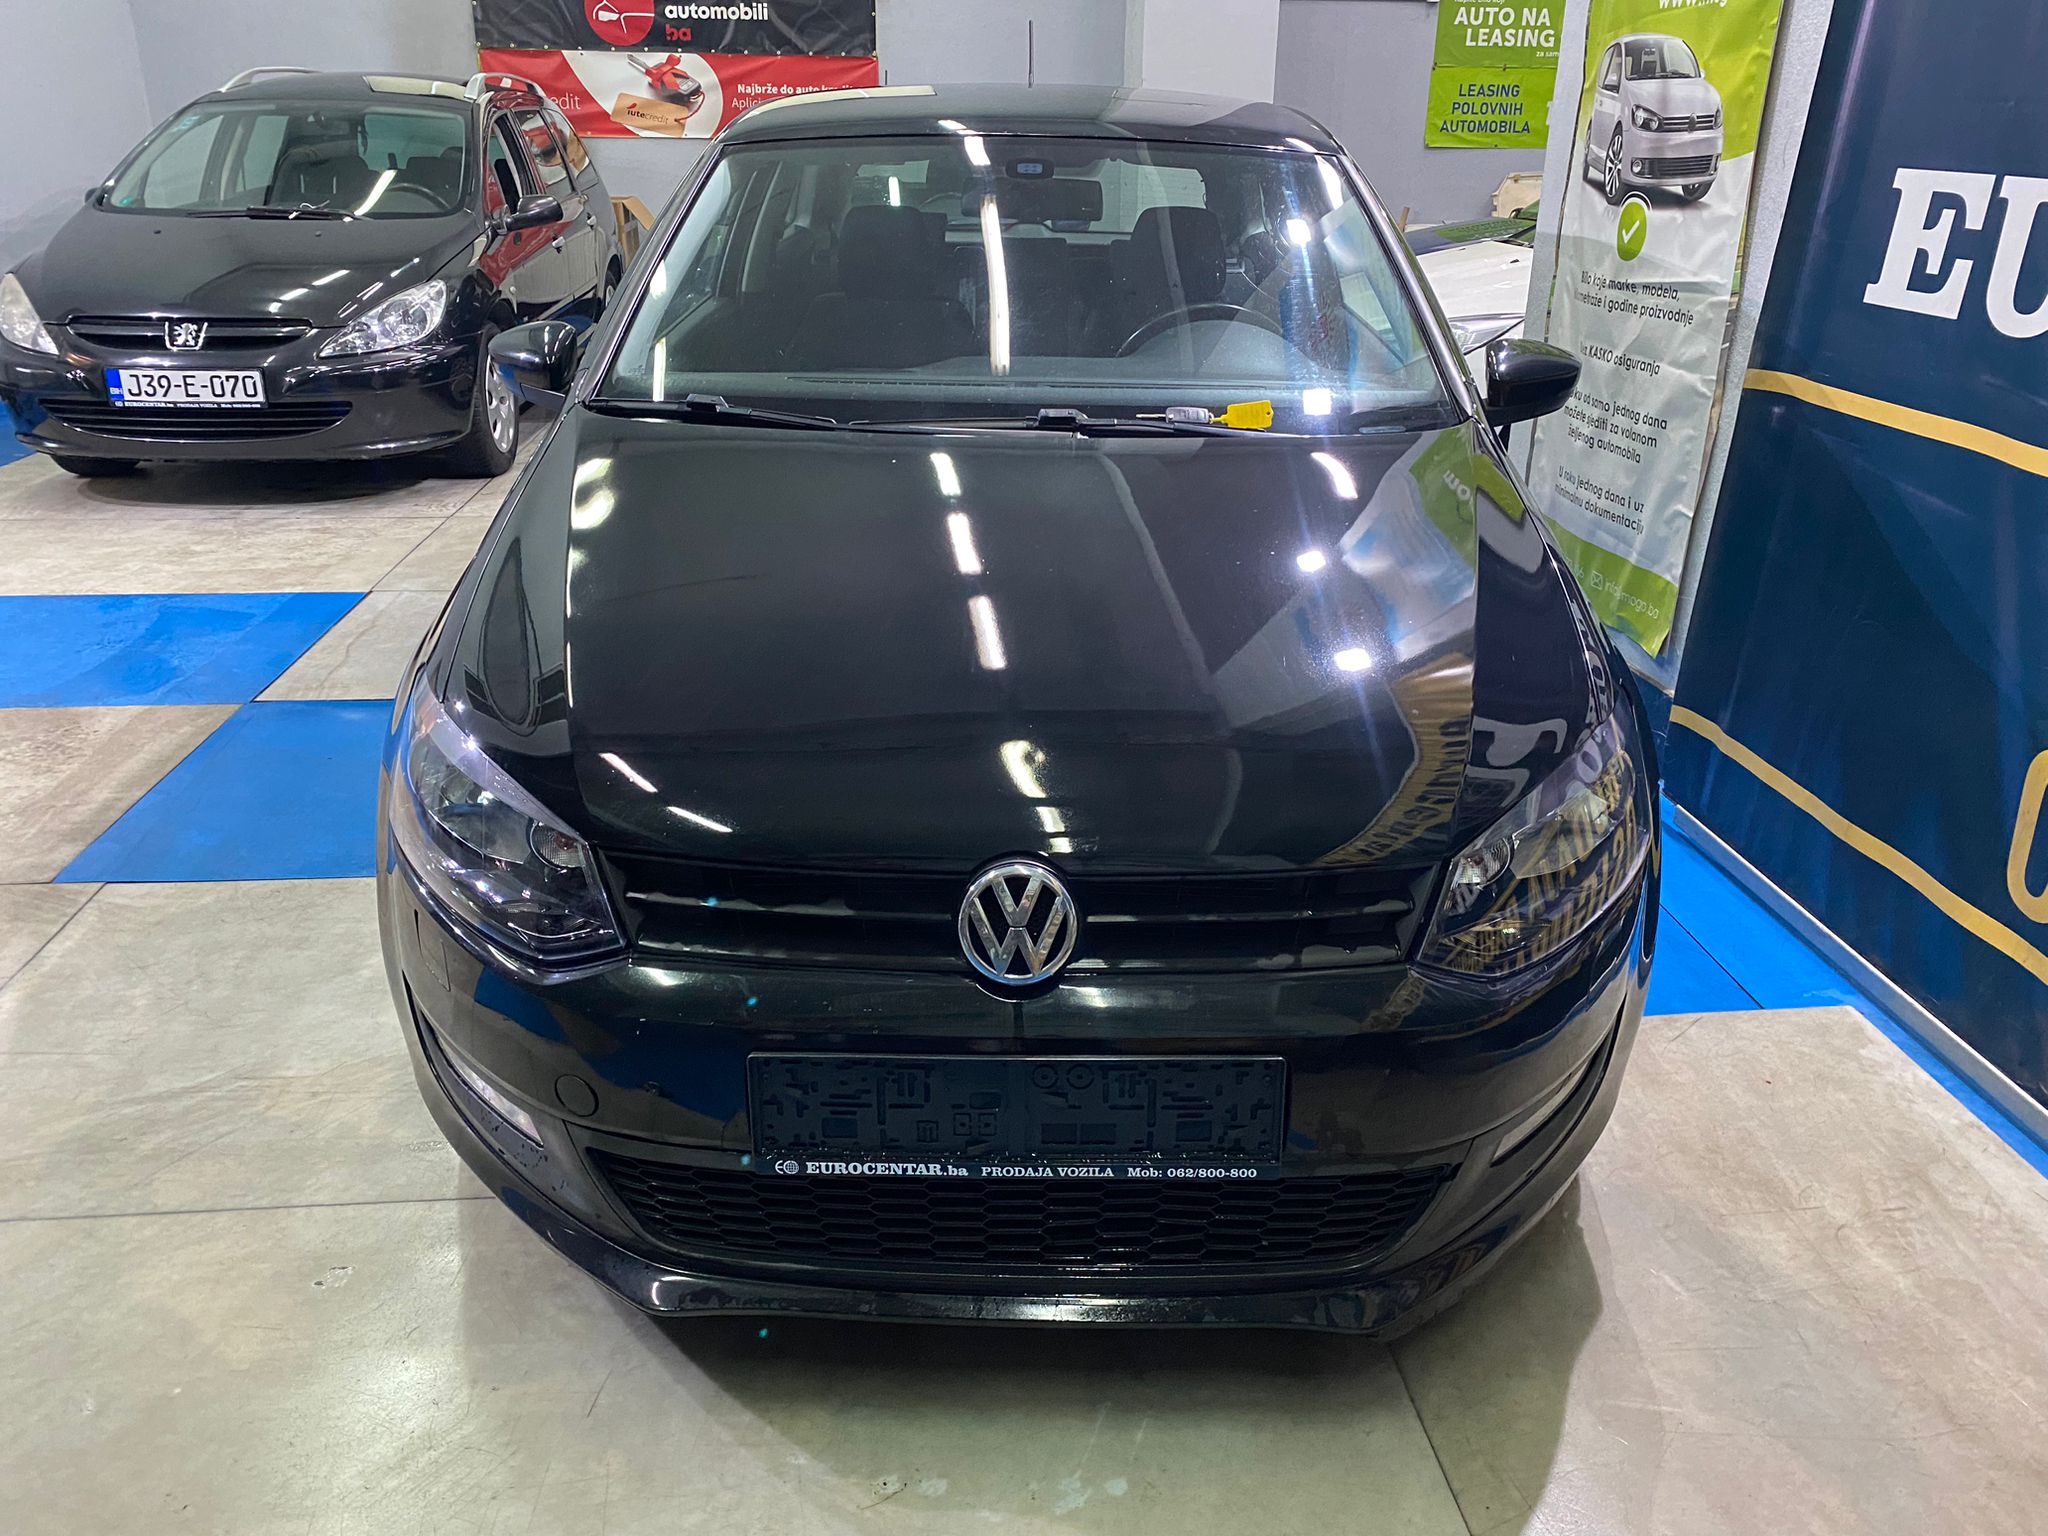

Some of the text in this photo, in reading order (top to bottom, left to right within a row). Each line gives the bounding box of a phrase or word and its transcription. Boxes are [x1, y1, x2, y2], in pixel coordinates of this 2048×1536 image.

[664, 3, 769, 20] automobili
[1454, 7, 1551, 27] AUTO NA
[1465, 28, 1555, 47] LEASING
[737, 83, 778, 95] Najbrže
[780, 85, 794, 94] do
[1458, 84, 1520, 97] LEASING
[549, 93, 581, 110] edit
[1452, 102, 1523, 116] POLOVNIH
[626, 108, 669, 125] iutecredit
[1440, 120, 1531, 133] AUTOMOBILA
[1608, 279, 1639, 295] marke,
[1642, 284, 1680, 302] modela,
[1607, 299, 1638, 314] godine
[1640, 304, 1694, 327] proizvodnje
[1588, 344, 1613, 363] KASKO
[1613, 352, 1660, 377] osiguranja
[128, 374, 258, 398] J39-E-070
[1612, 401, 1641, 425] jednog
[1642, 412, 1668, 431] dana
[1609, 423, 1619, 435] za
[1620, 427, 1657, 448] volanom
[1597, 438, 1641, 464] automobila
[1576, 475, 1603, 500] jednog
[1604, 488, 1625, 507] dana
[1633, 501, 1645, 514] uz
[1584, 500, 1644, 535] dokumentaciju
[806, 1161, 1257, 1178] EUROCENTAR.ba PRODAJA VOZILA Mob: 062/800-800
